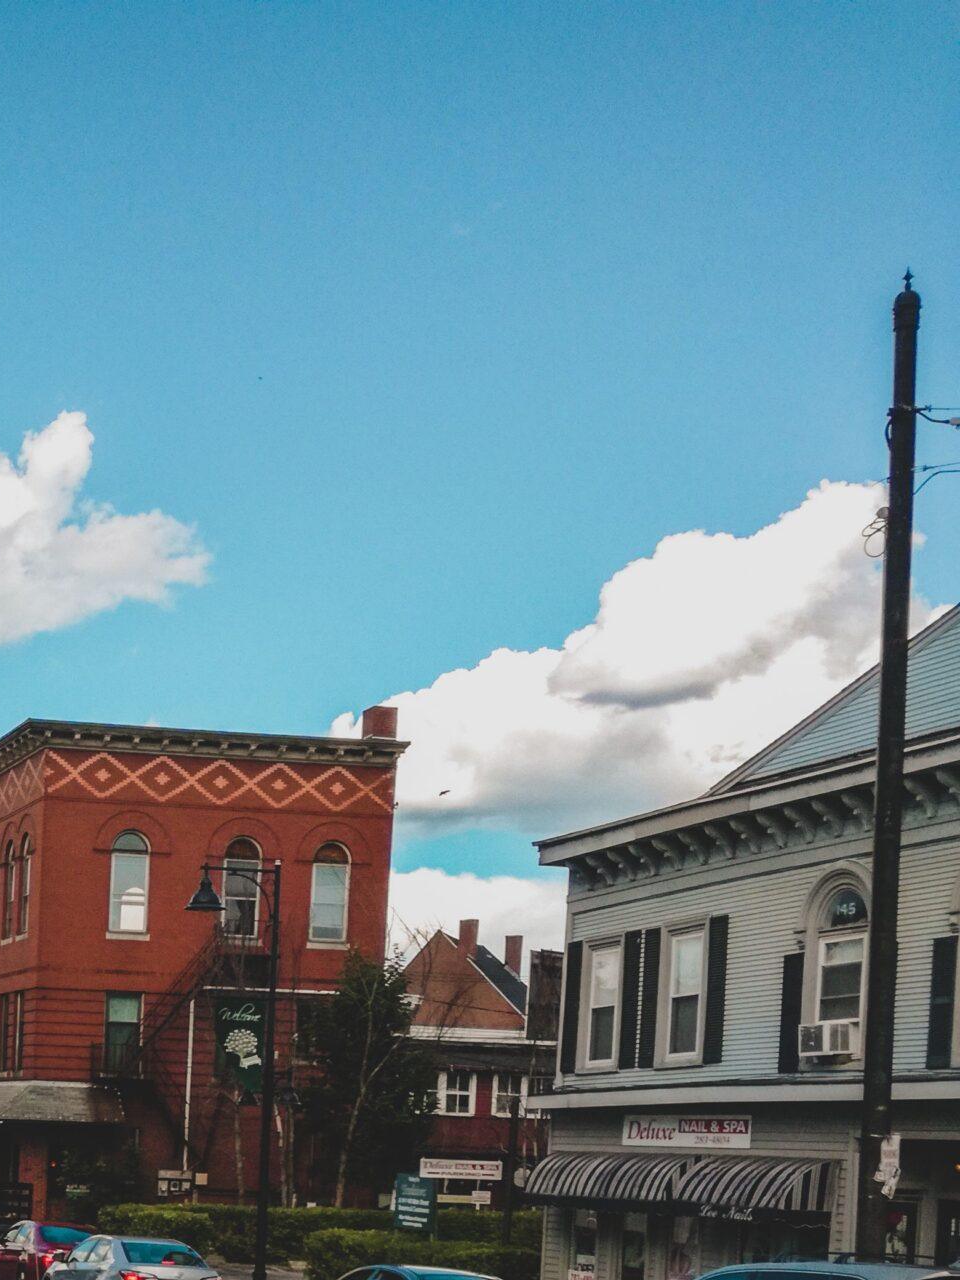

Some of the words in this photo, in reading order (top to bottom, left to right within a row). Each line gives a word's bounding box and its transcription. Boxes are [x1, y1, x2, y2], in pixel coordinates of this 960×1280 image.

[836, 902, 856, 916] 145
[218, 1002, 262, 1021] Welcome
[627, 1120, 676, 1140] Deluxe
[680, 1120, 708, 1132] NAIL
[710, 1120, 720, 1132] &
[722, 1120, 746, 1133] SPA
